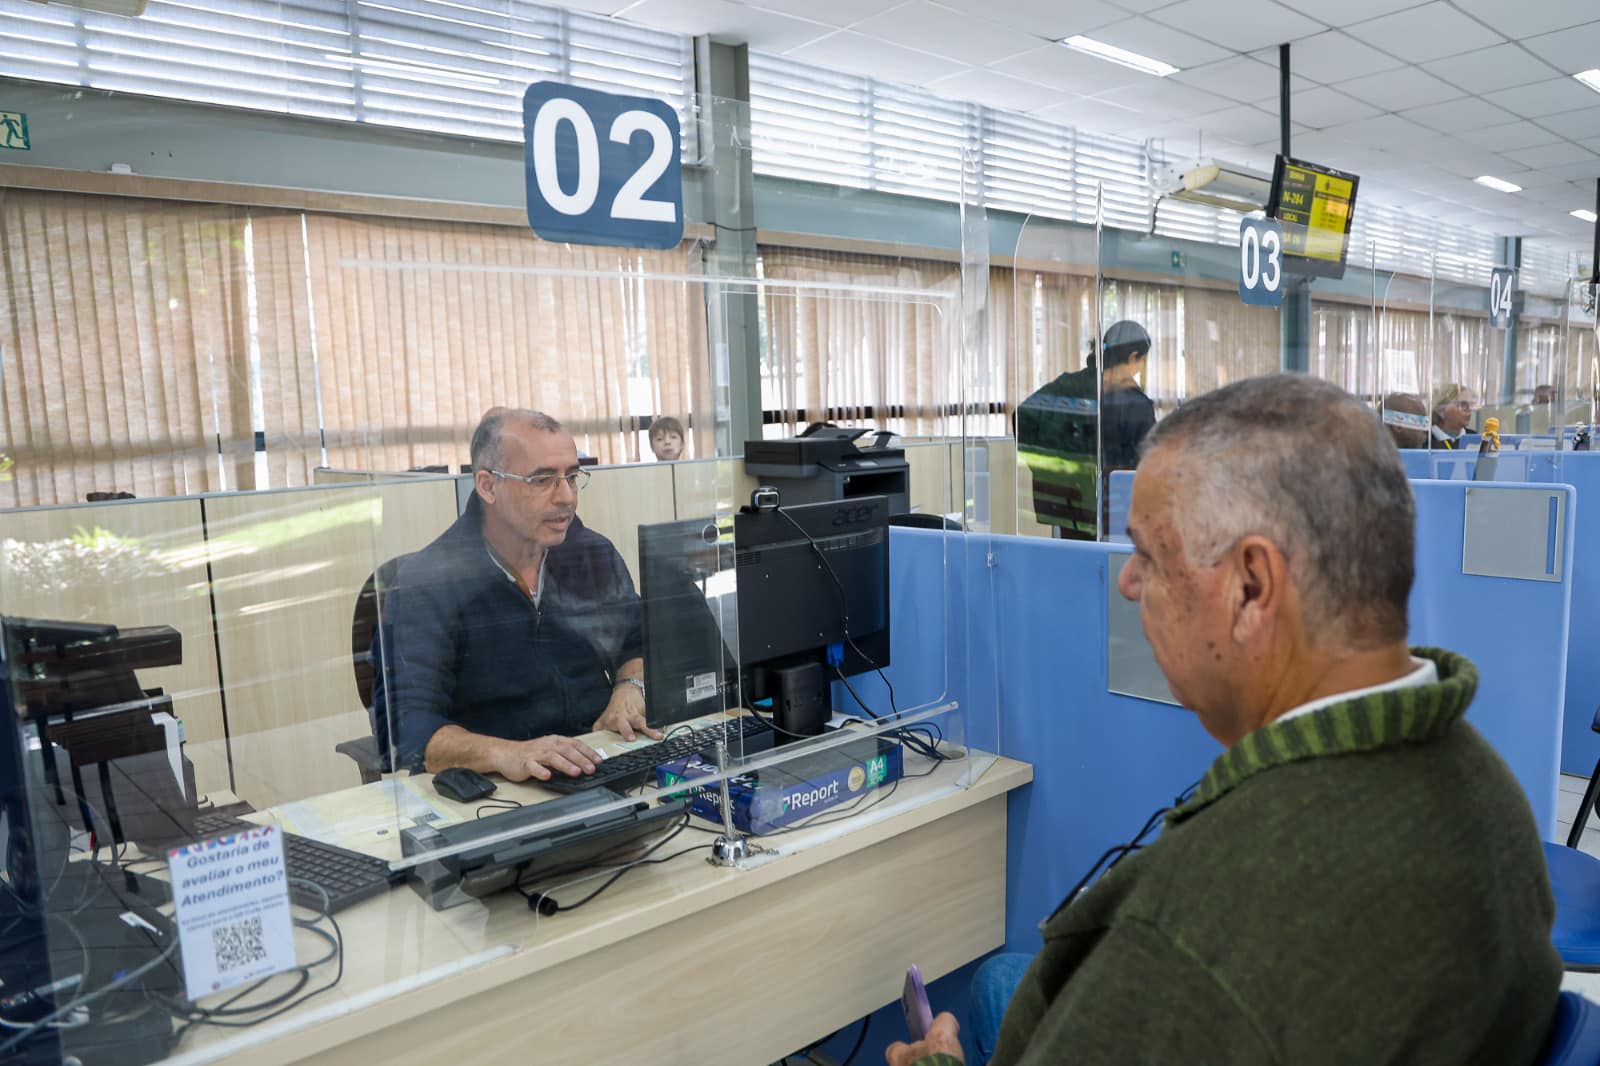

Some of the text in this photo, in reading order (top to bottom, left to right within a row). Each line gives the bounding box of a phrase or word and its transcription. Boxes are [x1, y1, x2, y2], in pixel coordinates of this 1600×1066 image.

[533, 98, 676, 223] 02
[1242, 226, 1280, 292] 03
[1491, 273, 1512, 318] 04
[870, 757, 883, 774] A4
[791, 779, 839, 811] Report
[187, 839, 270, 868] Gostaria de
[181, 870, 284, 907] Atendimento?
[182, 856, 279, 888] avaliar o meu
